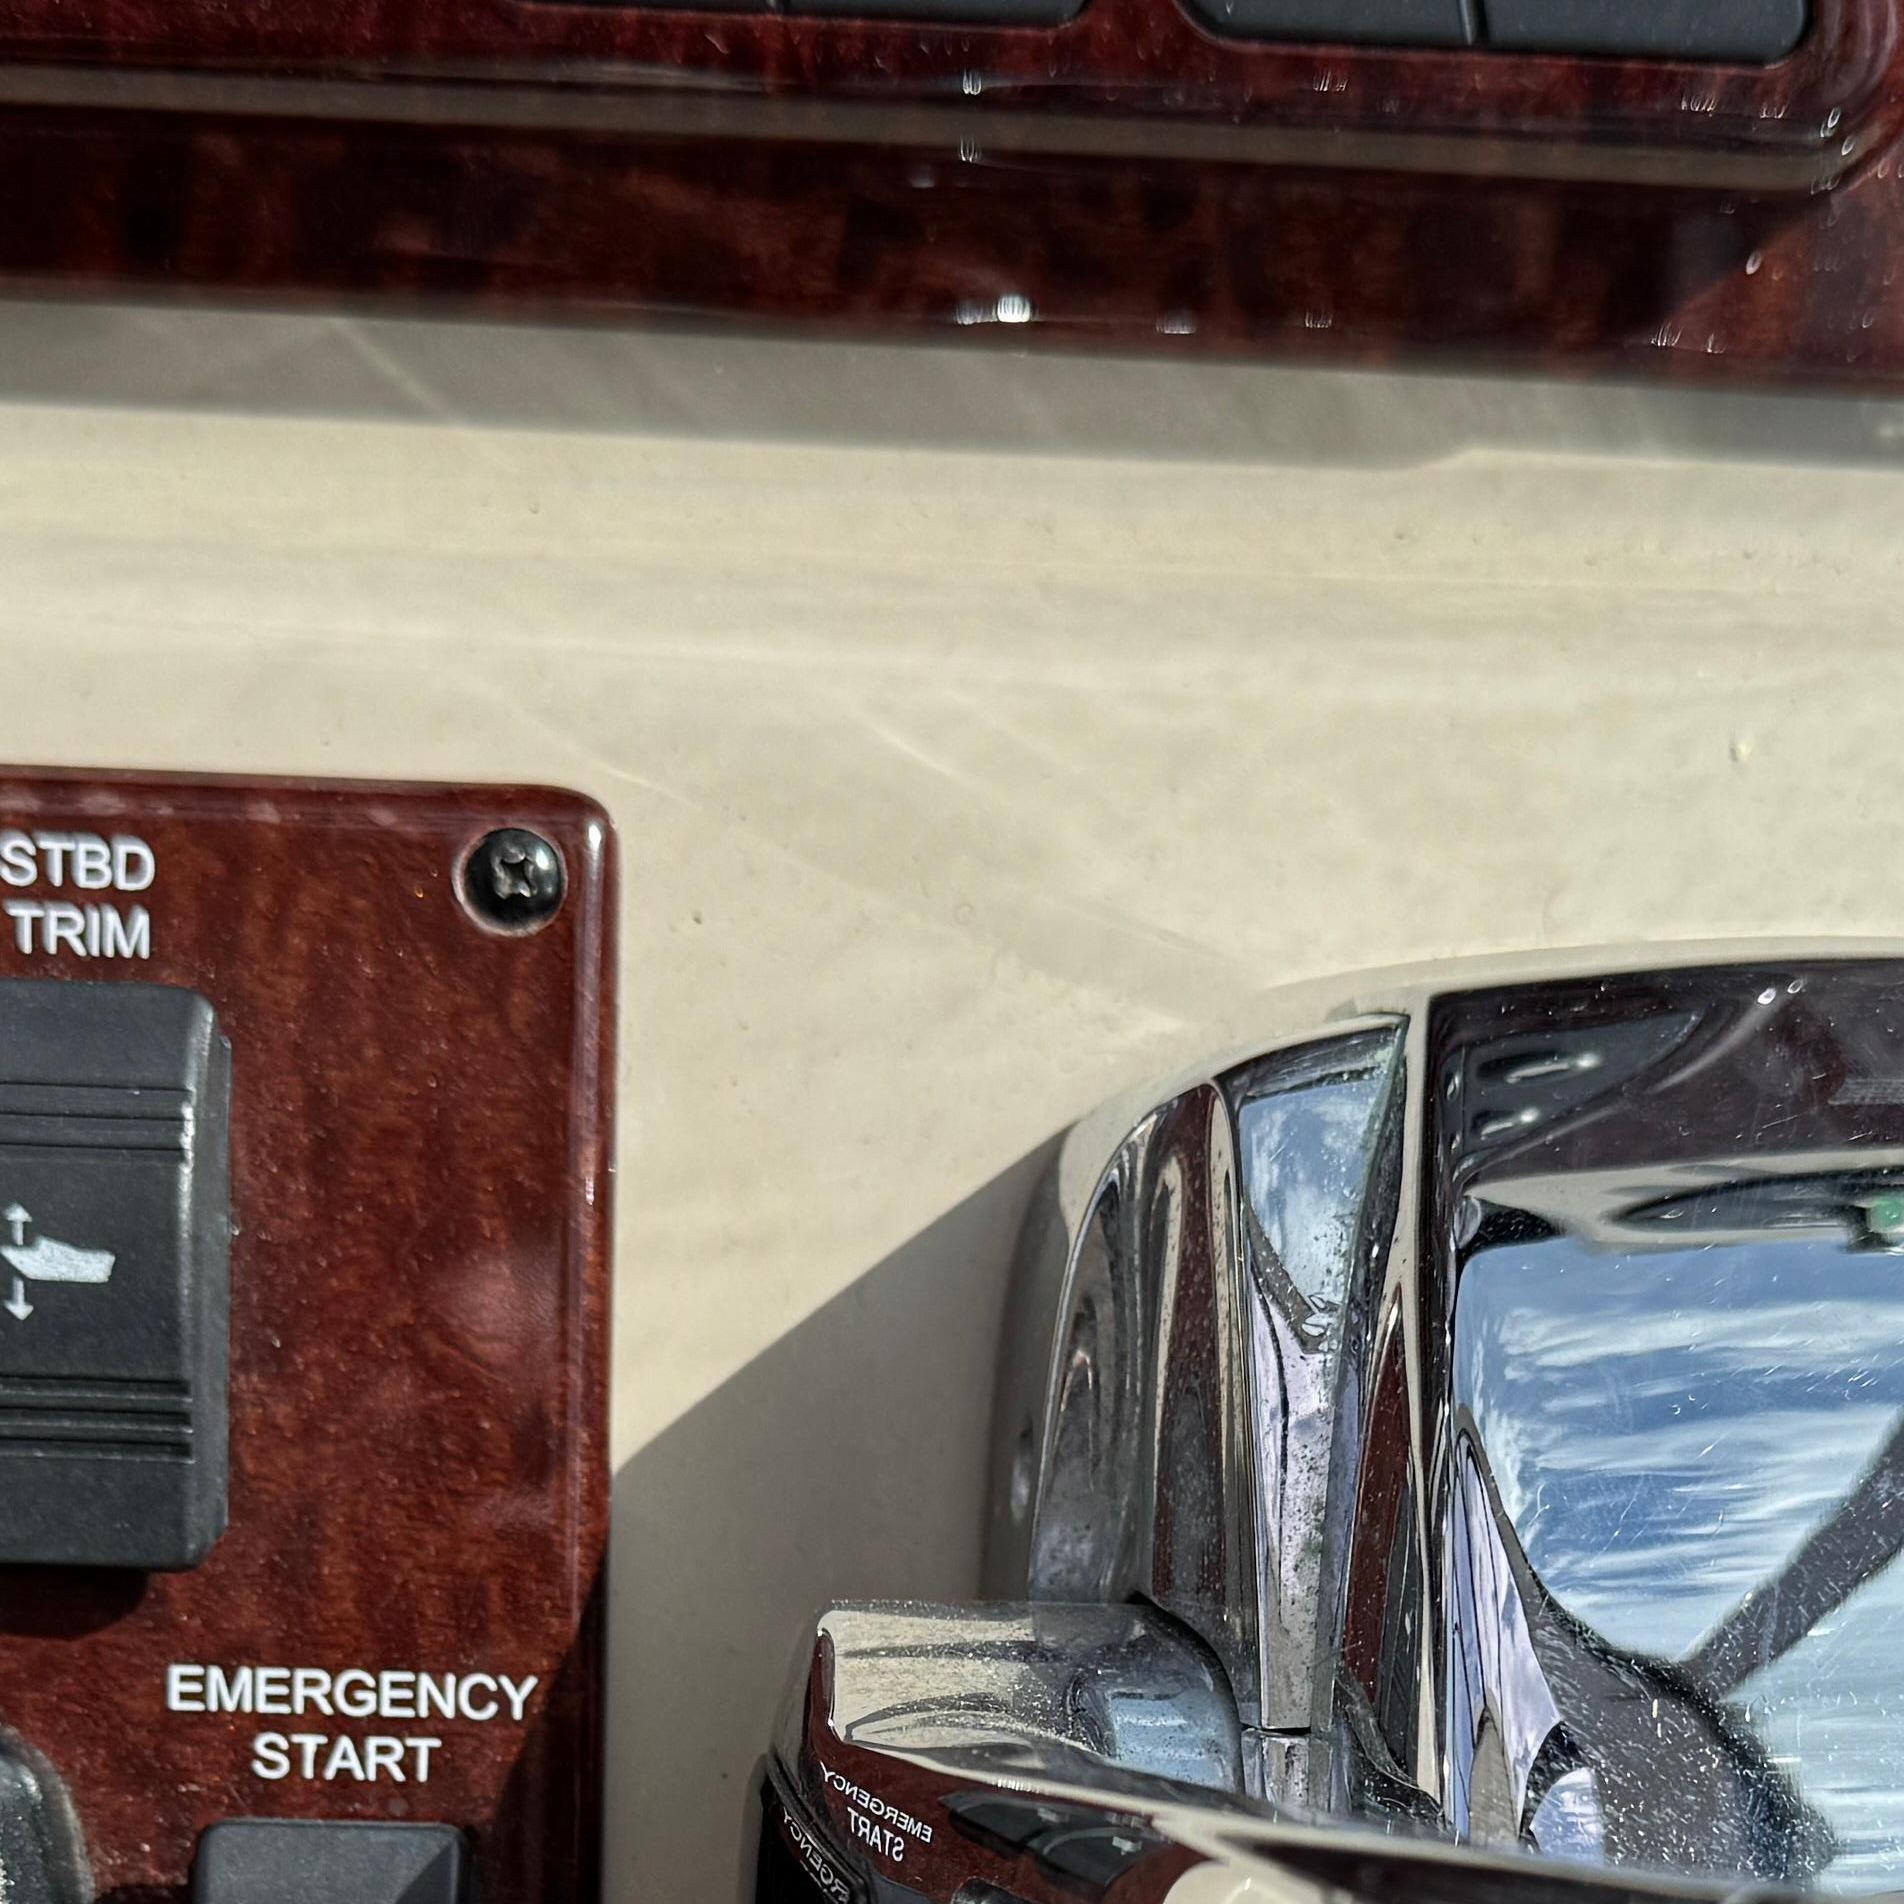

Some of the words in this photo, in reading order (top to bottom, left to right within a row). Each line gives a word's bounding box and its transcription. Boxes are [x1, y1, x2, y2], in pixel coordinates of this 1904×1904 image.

[5, 899, 151, 959] TRIM
[167, 1663, 538, 1720] EMERGENCY
[252, 1732, 441, 1782] START
